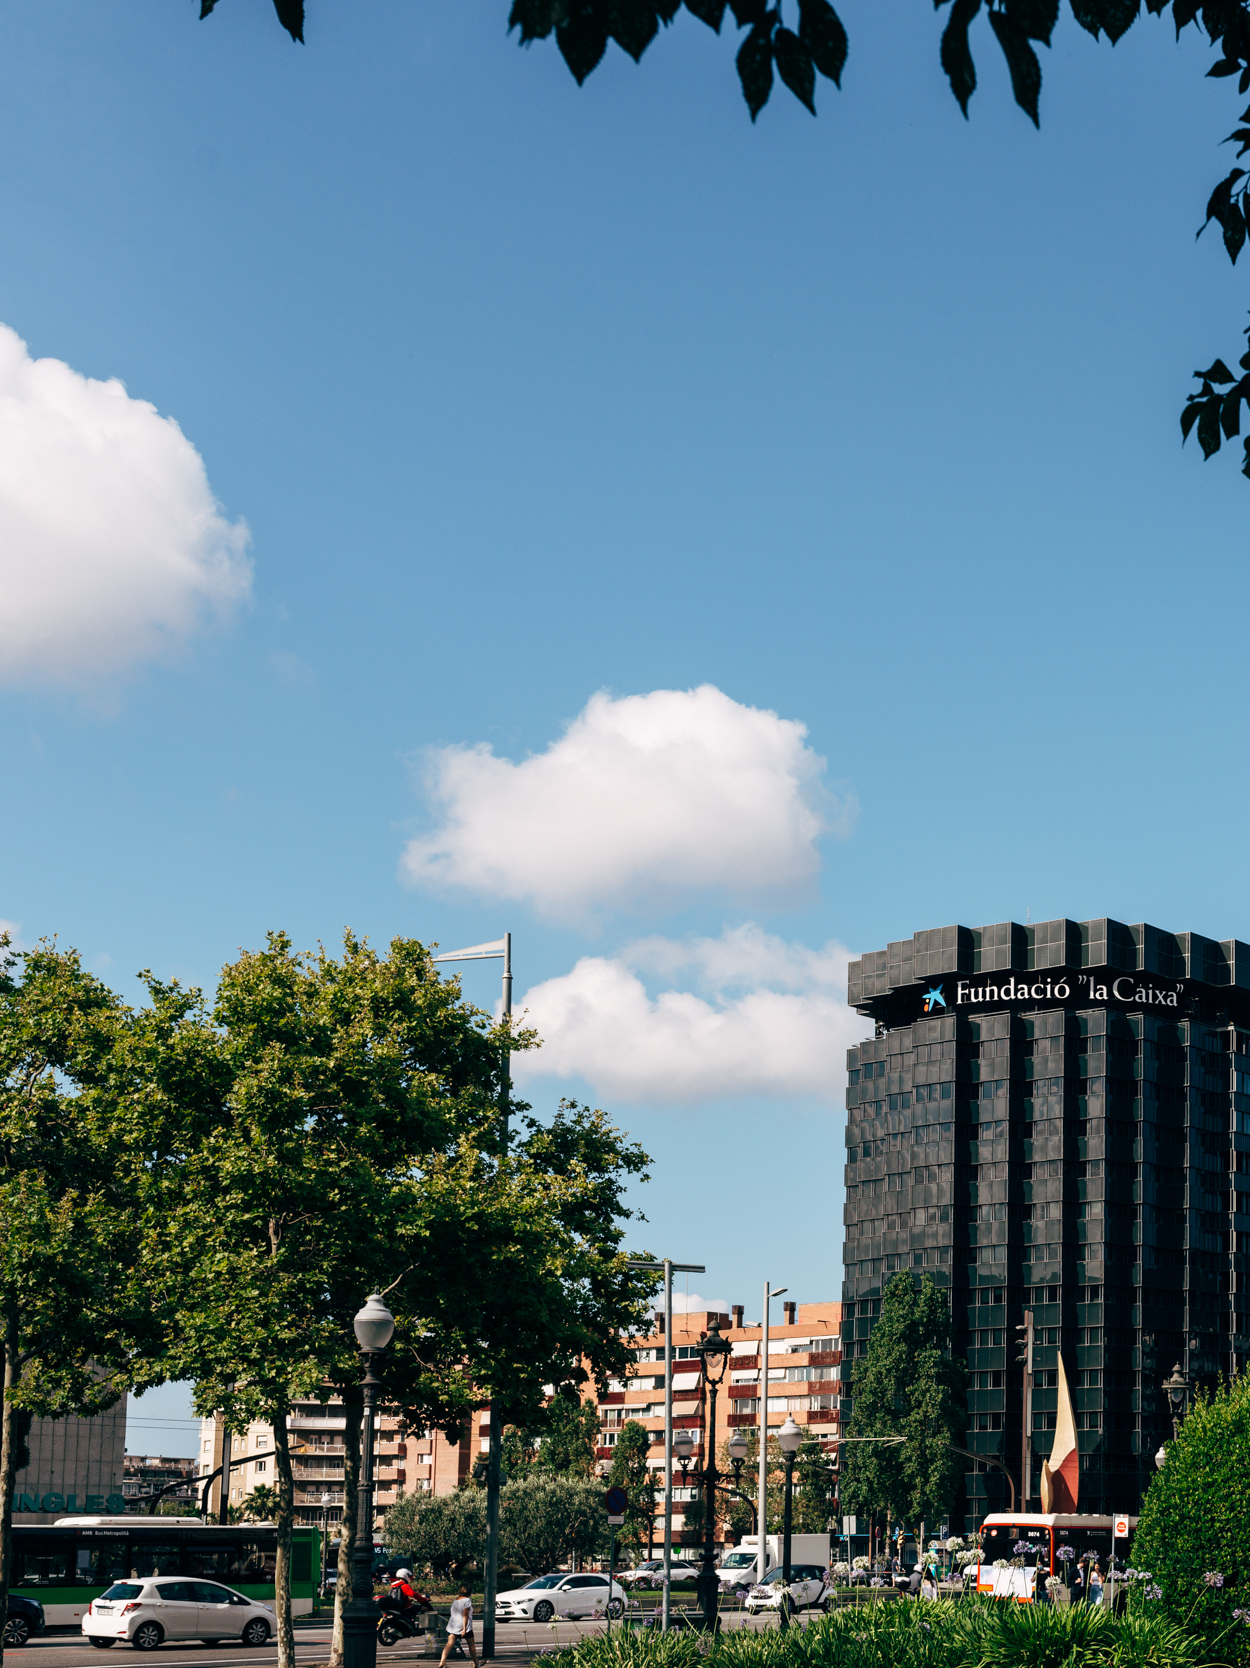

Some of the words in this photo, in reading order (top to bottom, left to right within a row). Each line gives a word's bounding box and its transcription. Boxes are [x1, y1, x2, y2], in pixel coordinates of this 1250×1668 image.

[956, 977, 1070, 1005] Fundació
[1078, 975, 1109, 1000] "la
[1113, 976, 1185, 1007] Caixa"
